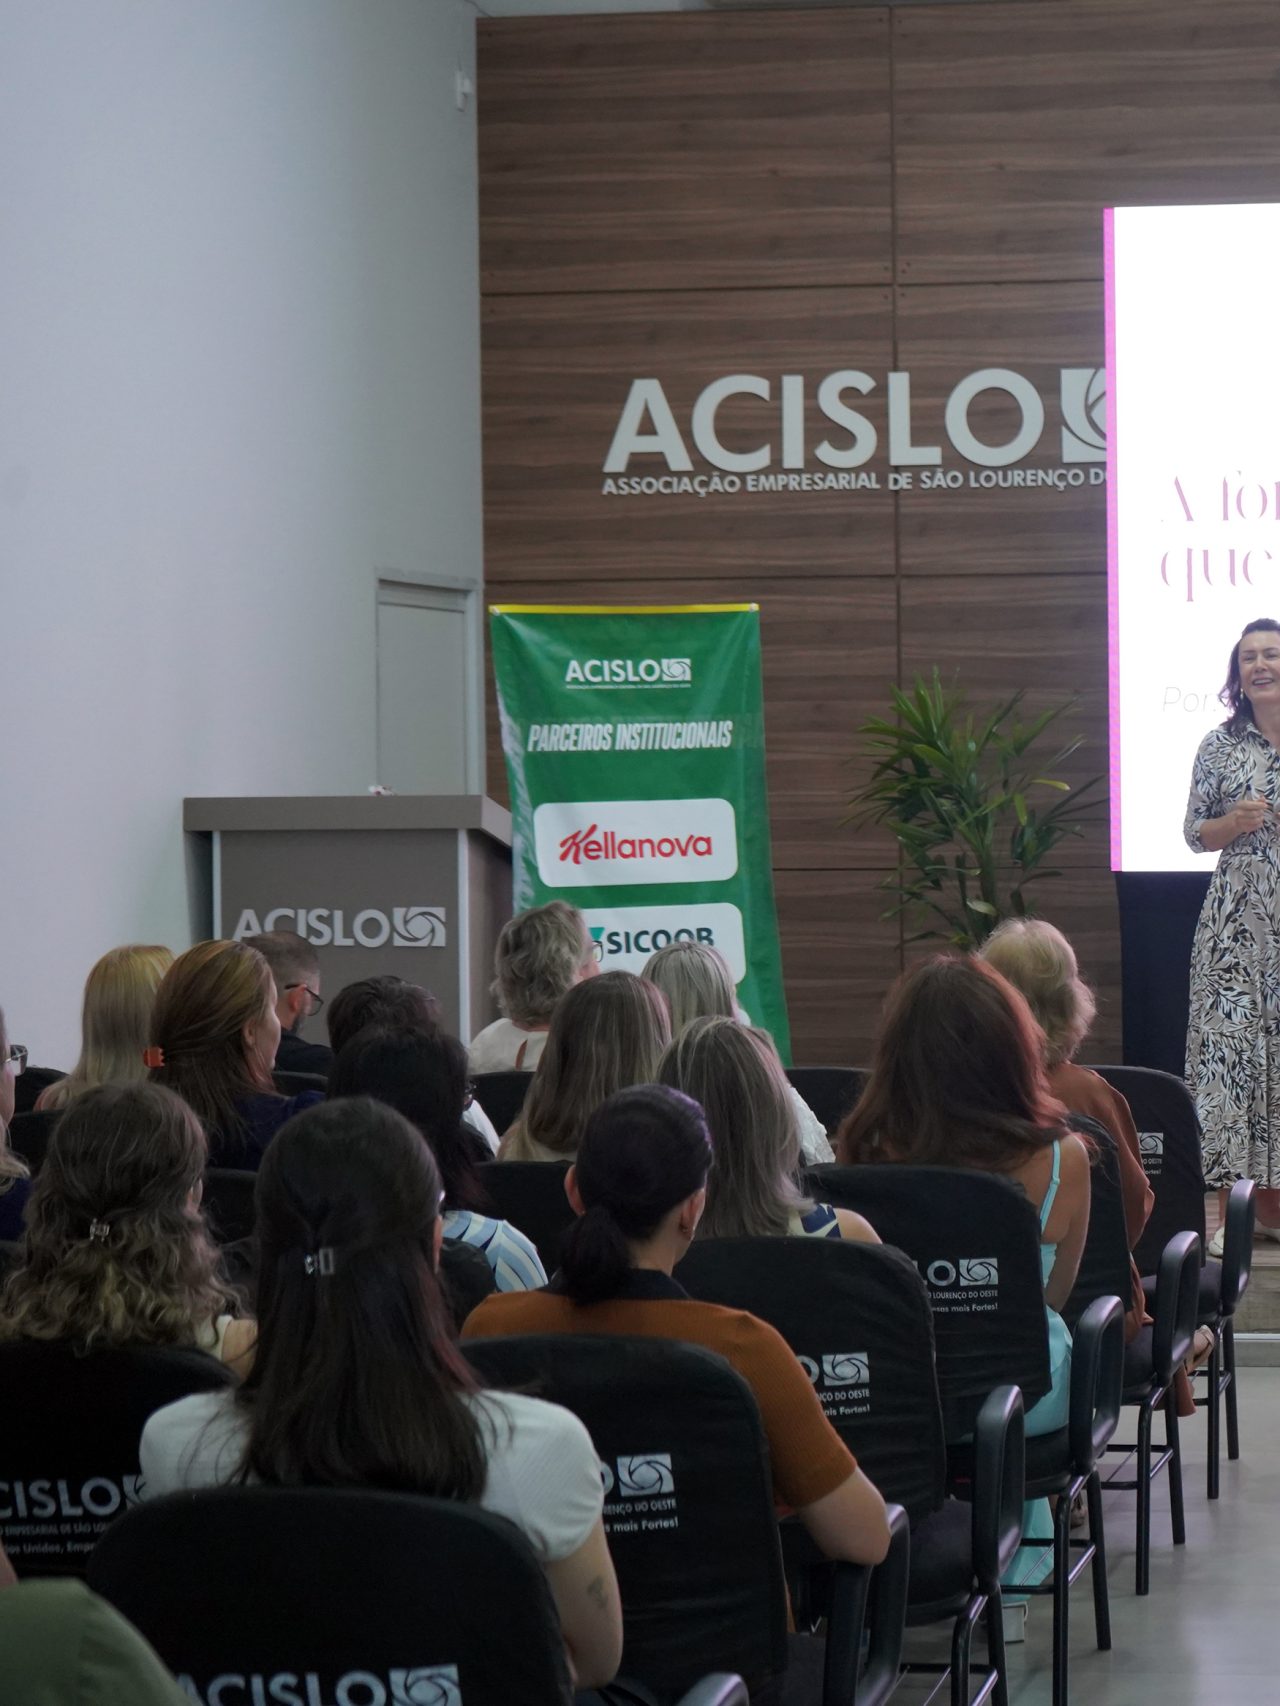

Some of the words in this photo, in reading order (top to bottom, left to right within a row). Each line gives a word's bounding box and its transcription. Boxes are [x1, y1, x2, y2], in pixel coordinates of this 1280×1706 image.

[602, 368, 1045, 473] ACISLO
[602, 472, 741, 498] ASSOCIAÇÃO
[746, 471, 881, 492] EMPRESARIAL
[888, 473, 912, 491] DE
[920, 468, 963, 489] SÃO
[969, 468, 1085, 491] LOURENÇO
[1089, 467, 1106, 486] D
[1160, 474, 1196, 522] A
[1159, 544, 1273, 603] que
[565, 659, 661, 682] ACISLO
[527, 723, 614, 752] PARCEIROS
[614, 720, 733, 751] INSTITUCIONAIS
[559, 823, 713, 865] Kellanova
[232, 907, 391, 948] ACISLO
[606, 927, 715, 955] SICOOB
[824, 1407, 837, 1417] ais
